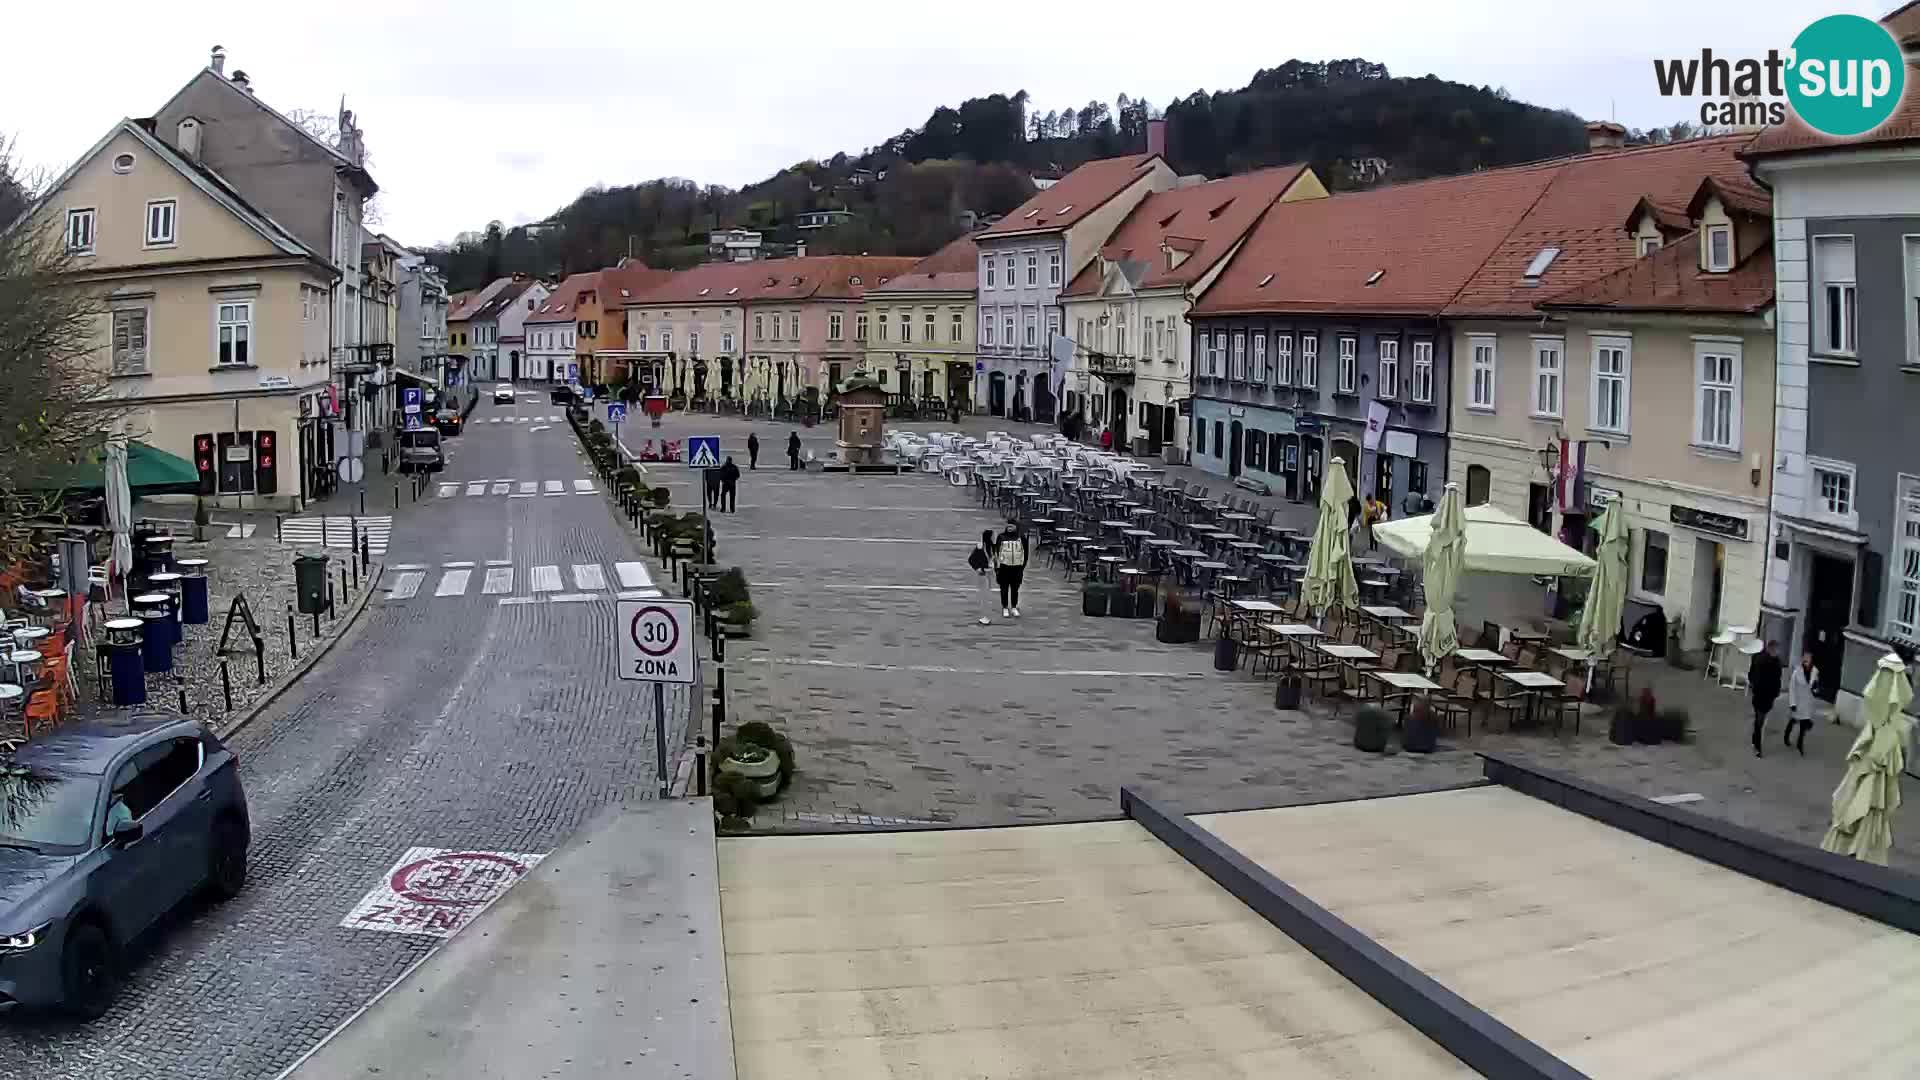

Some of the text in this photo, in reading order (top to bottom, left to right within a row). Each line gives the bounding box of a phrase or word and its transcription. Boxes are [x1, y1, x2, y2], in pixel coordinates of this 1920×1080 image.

[408, 391, 417, 402] P
[643, 621, 668, 643] 30
[634, 659, 678, 676] ZONA
